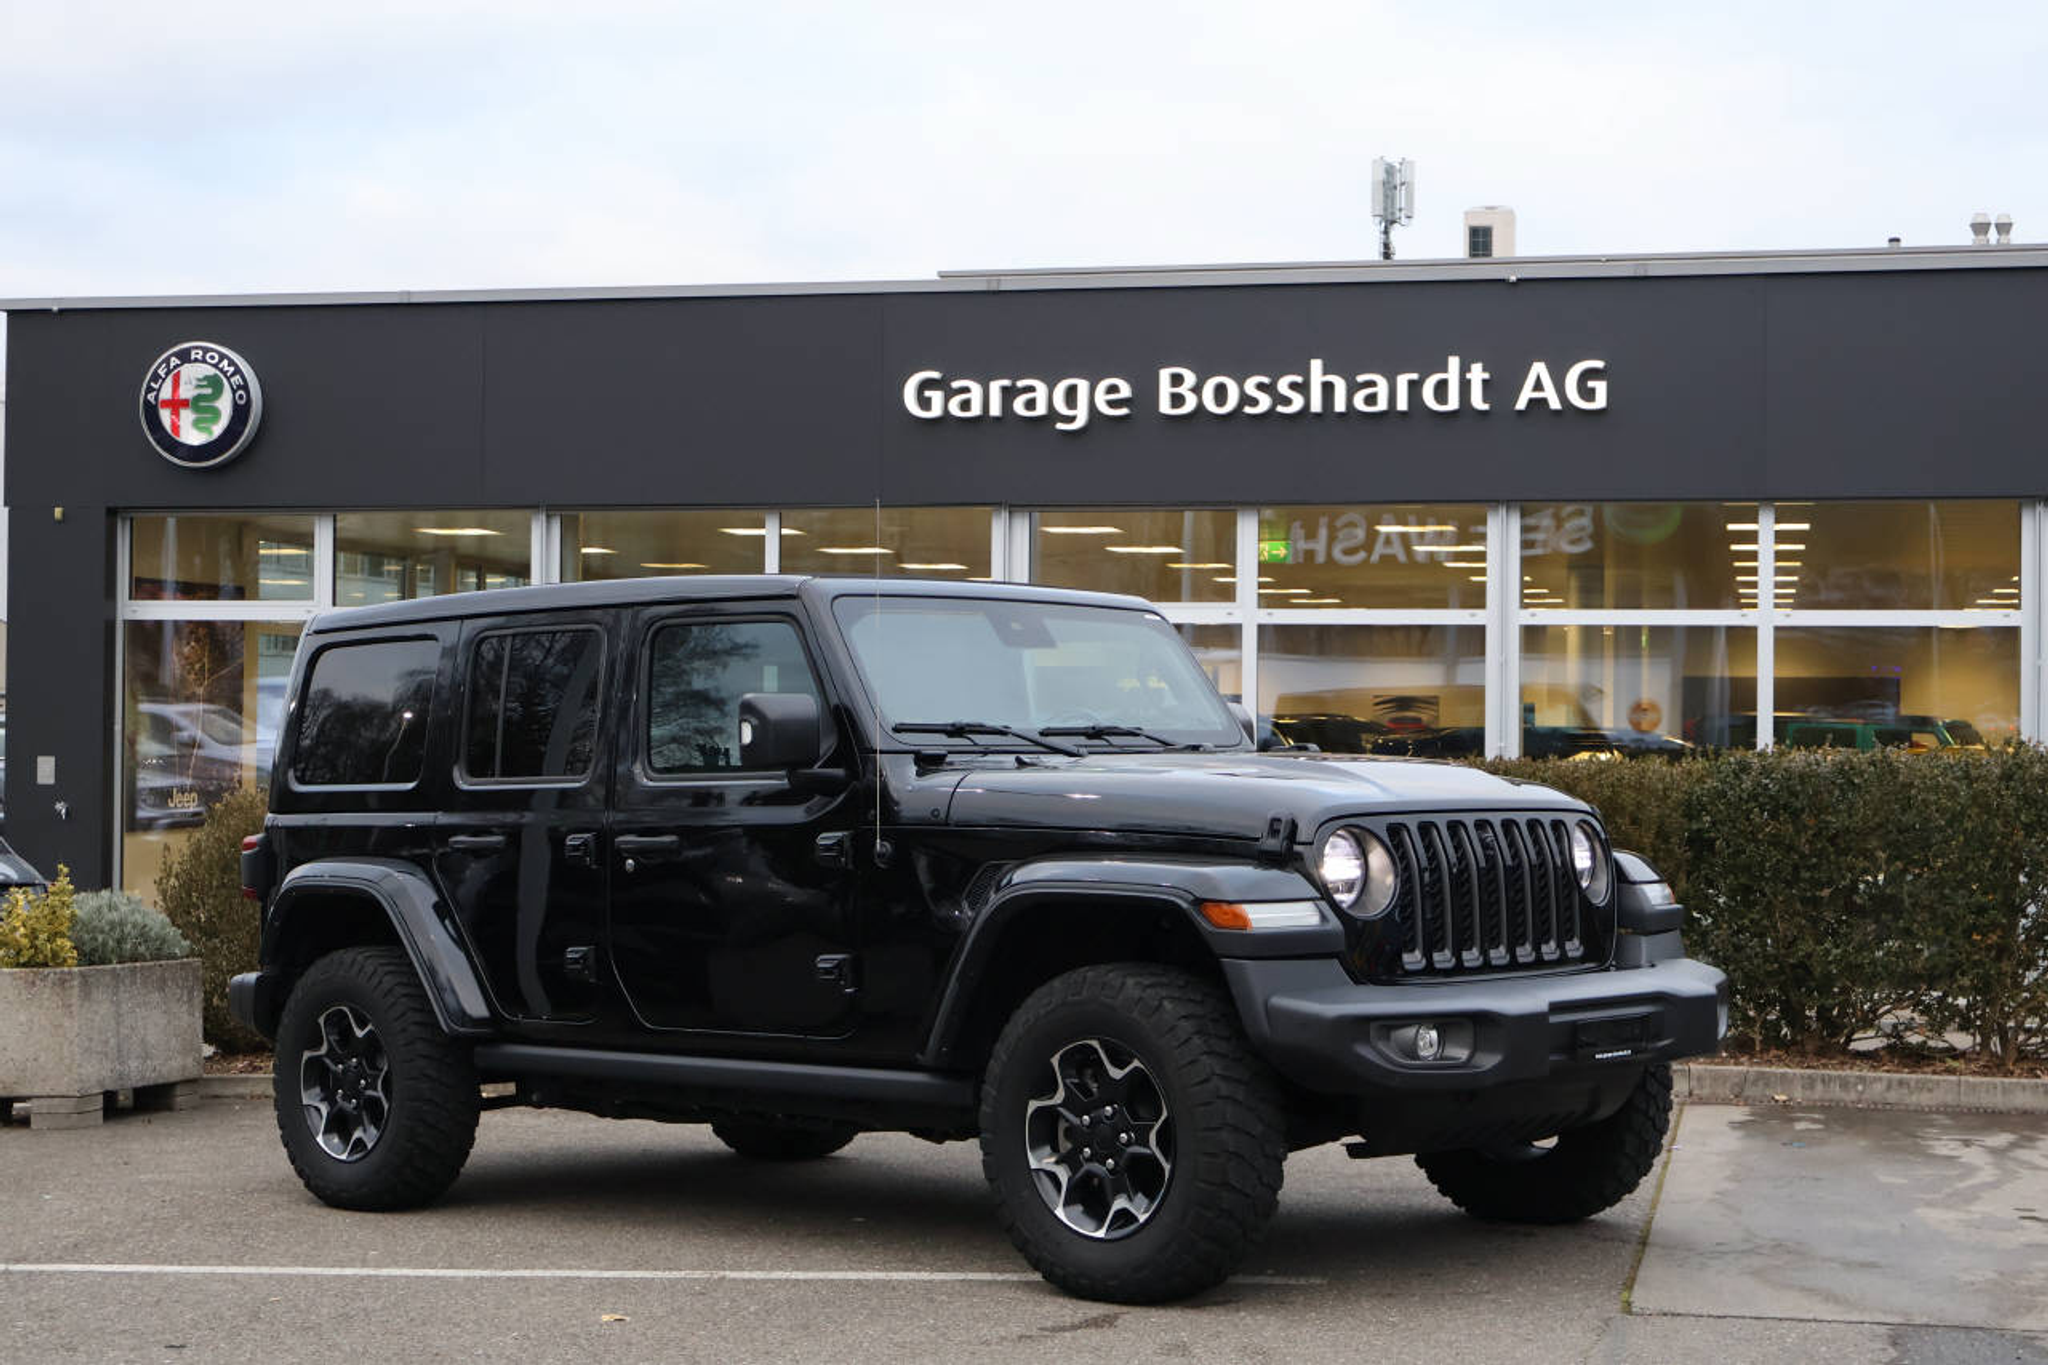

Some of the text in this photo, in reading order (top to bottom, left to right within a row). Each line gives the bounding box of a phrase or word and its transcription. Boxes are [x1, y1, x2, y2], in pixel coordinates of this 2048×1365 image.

[146, 349, 247, 406] ALFA ROMEO
[903, 356, 1608, 431] Garage Bosshardt AG
[167, 787, 198, 811] Jeep
